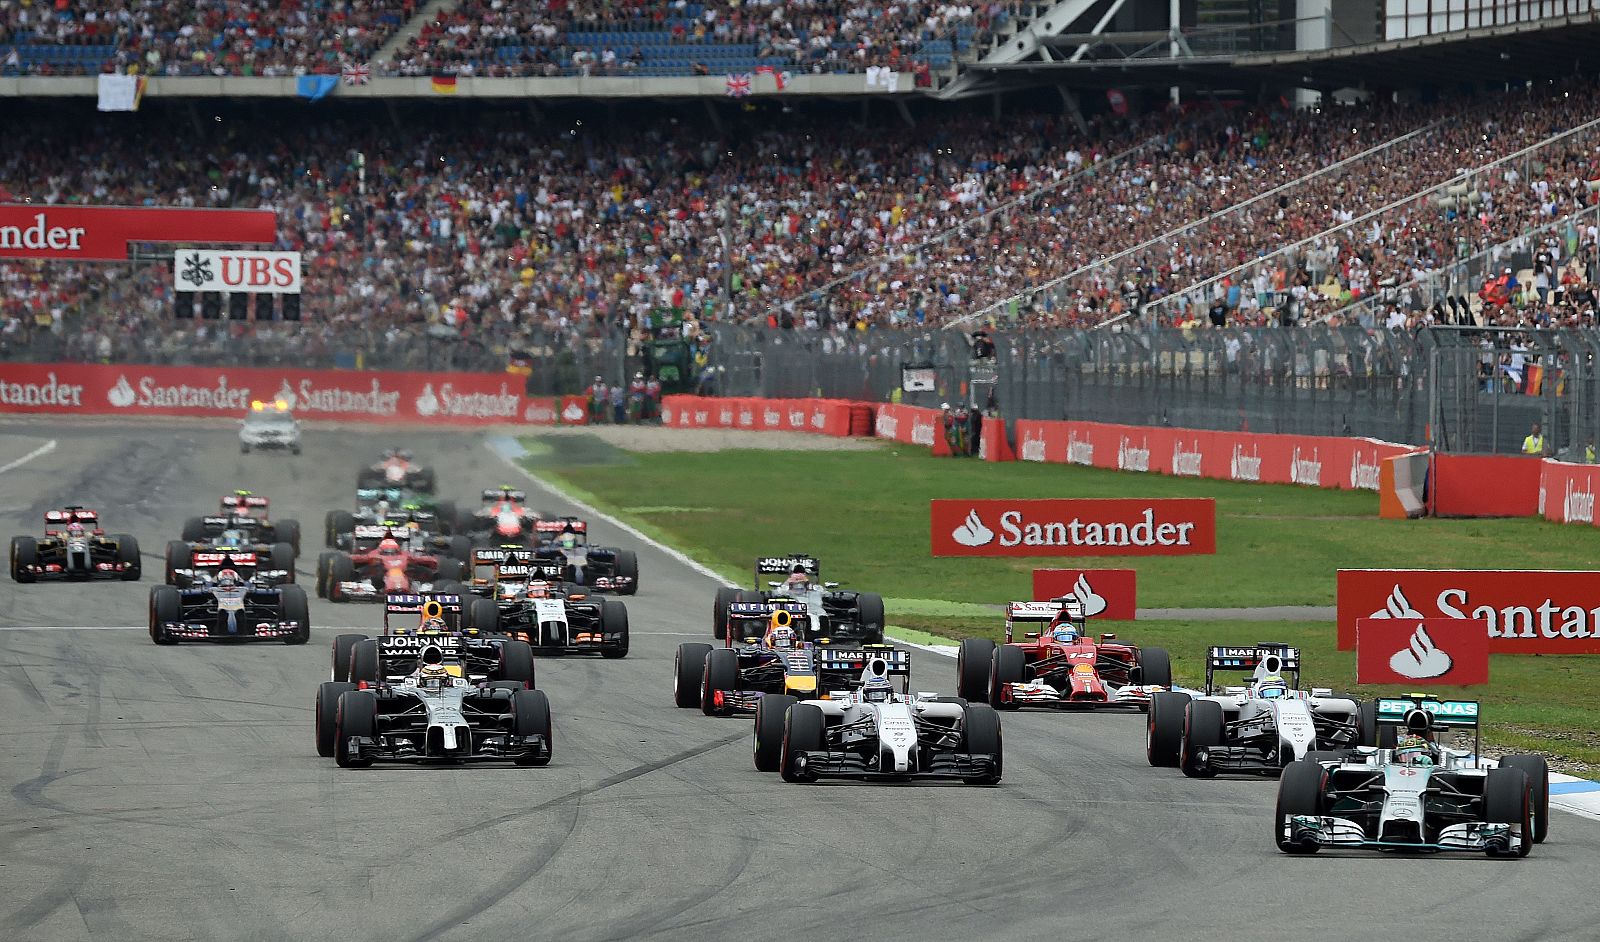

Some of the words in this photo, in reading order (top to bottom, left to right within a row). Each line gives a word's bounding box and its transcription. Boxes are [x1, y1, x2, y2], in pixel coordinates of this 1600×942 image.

[219, 256, 294, 287] UBS
[138, 375, 250, 409] Santander
[999, 507, 1195, 547] Santander
[731, 603, 803, 611] INFINTI
